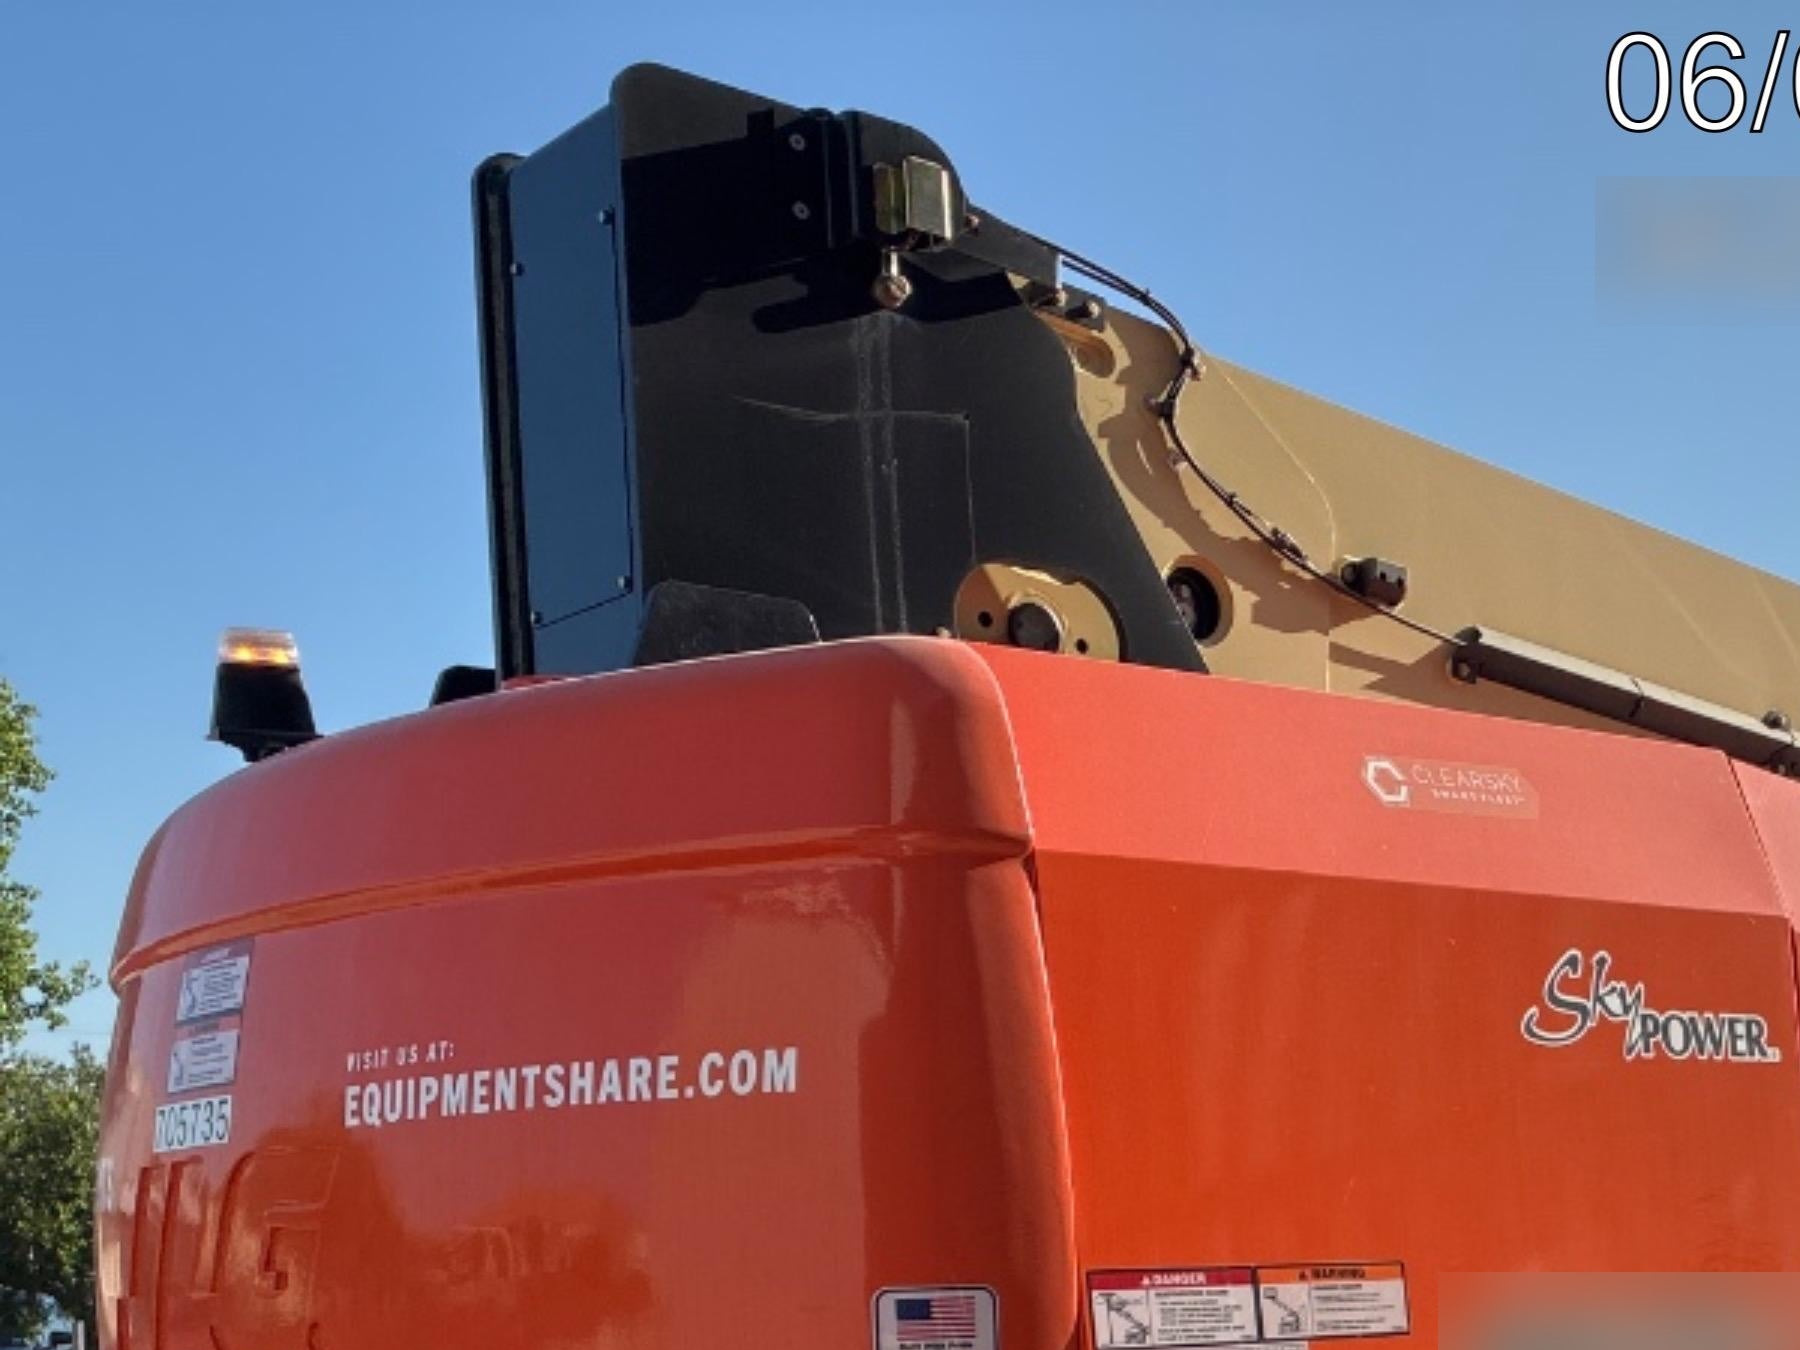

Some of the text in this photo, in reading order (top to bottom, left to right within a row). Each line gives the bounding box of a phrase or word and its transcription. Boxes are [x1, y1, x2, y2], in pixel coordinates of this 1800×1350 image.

[1411, 764, 1524, 794] CLEARSKY
[1520, 947, 1645, 1061] Sky
[346, 1040, 455, 1073] VISIT US AT:
[344, 1046, 798, 1129] EQUIPMENTSHARE.COM
[156, 1098, 230, 1148] 705735
